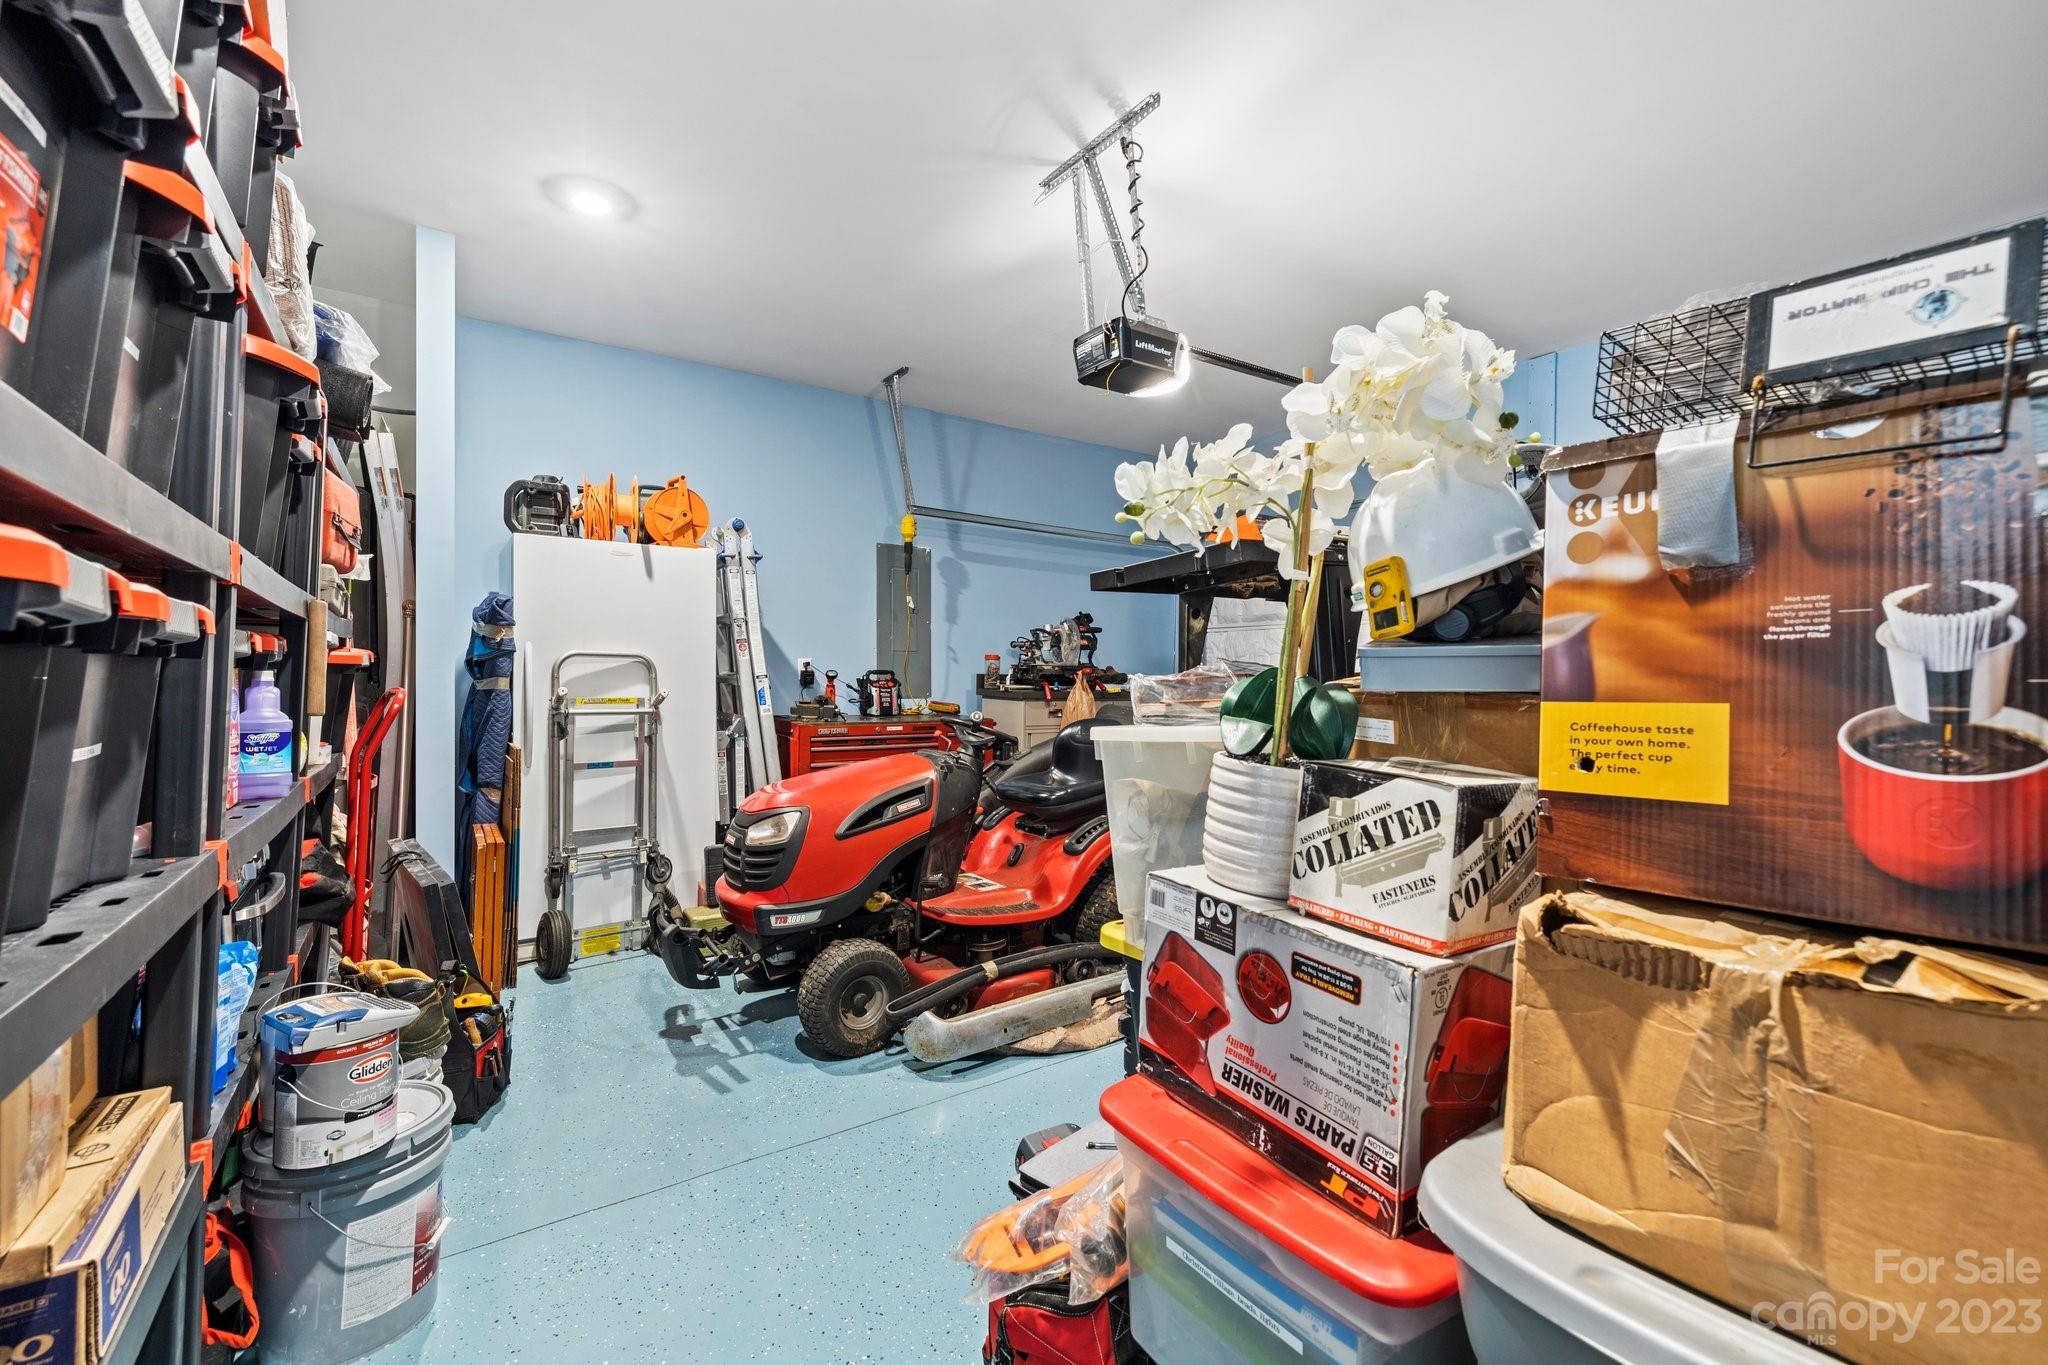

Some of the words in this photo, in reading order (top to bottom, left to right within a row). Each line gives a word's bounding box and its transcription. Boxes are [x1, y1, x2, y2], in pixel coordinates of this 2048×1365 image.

[1947, 262, 1994, 283] THE
[1135, 339, 1172, 357] LiftMaster
[1570, 722, 1652, 734] Coffeehouse
[1656, 725, 1695, 735] taste
[244, 733, 280, 745] Swiffer
[1569, 735, 1581, 745] in
[1584, 737, 1612, 749] your
[1615, 740, 1644, 748] own
[1648, 738, 1691, 750] home.
[1569, 748, 1592, 758] The
[1595, 750, 1644, 763] perfect
[1647, 755, 1673, 764] cup
[1607, 764, 1641, 775] time.
[1292, 799, 1441, 880] COLLATED
[1449, 806, 1538, 922] COLLATE
[1372, 874, 1437, 904] FASTENERS
[1340, 912, 1374, 930] FRAMING
[1379, 925, 1433, 949] BASTIDORES
[1295, 970, 1310, 982] TRAY
[1312, 977, 1354, 1001] REMOVEABLE
[1302, 1009, 1336, 1031] construction
[1338, 1014, 1354, 1029] pump
[1316, 1026, 1336, 1042] solvent
[1337, 1025, 1350, 1038] steel
[1351, 1031, 1371, 1047] gauge
[1225, 1032, 1254, 1058] Quality
[1322, 1040, 1337, 1054] metal
[1336, 1034, 1362, 1055] cleaning
[1371, 1041, 1390, 1058] Heavy
[1380, 1035, 1391, 1047] 110
[1224, 1044, 1276, 1082] Professional
[1289, 1051, 1303, 1066] parts
[1338, 1048, 1361, 1066] Flexible
[1362, 1047, 1389, 1069] Recycles
[350, 1058, 393, 1080] Glidden
[1303, 1060, 1318, 1074] small
[1302, 1075, 1323, 1096] PIEZAS
[1318, 1067, 1342, 1088] cleaning
[1221, 1061, 1289, 1119] WASHER
[1324, 1088, 1333, 1101] DE
[1343, 1081, 1352, 1093] for
[1352, 1087, 1364, 1100] tool
[341, 1091, 377, 1109] Ceiling
[1322, 1099, 1332, 1113] DE
[1333, 1093, 1360, 1116] LAVADO
[1365, 1093, 1381, 1108] great
[1332, 1105, 1359, 1129] TANQUE
[1294, 1104, 1356, 1159] PARTS
[1367, 1138, 1394, 1162] GALLON
[1182, 1251, 1212, 1279] Christmas
[1260, 1314, 1281, 1334] lights
